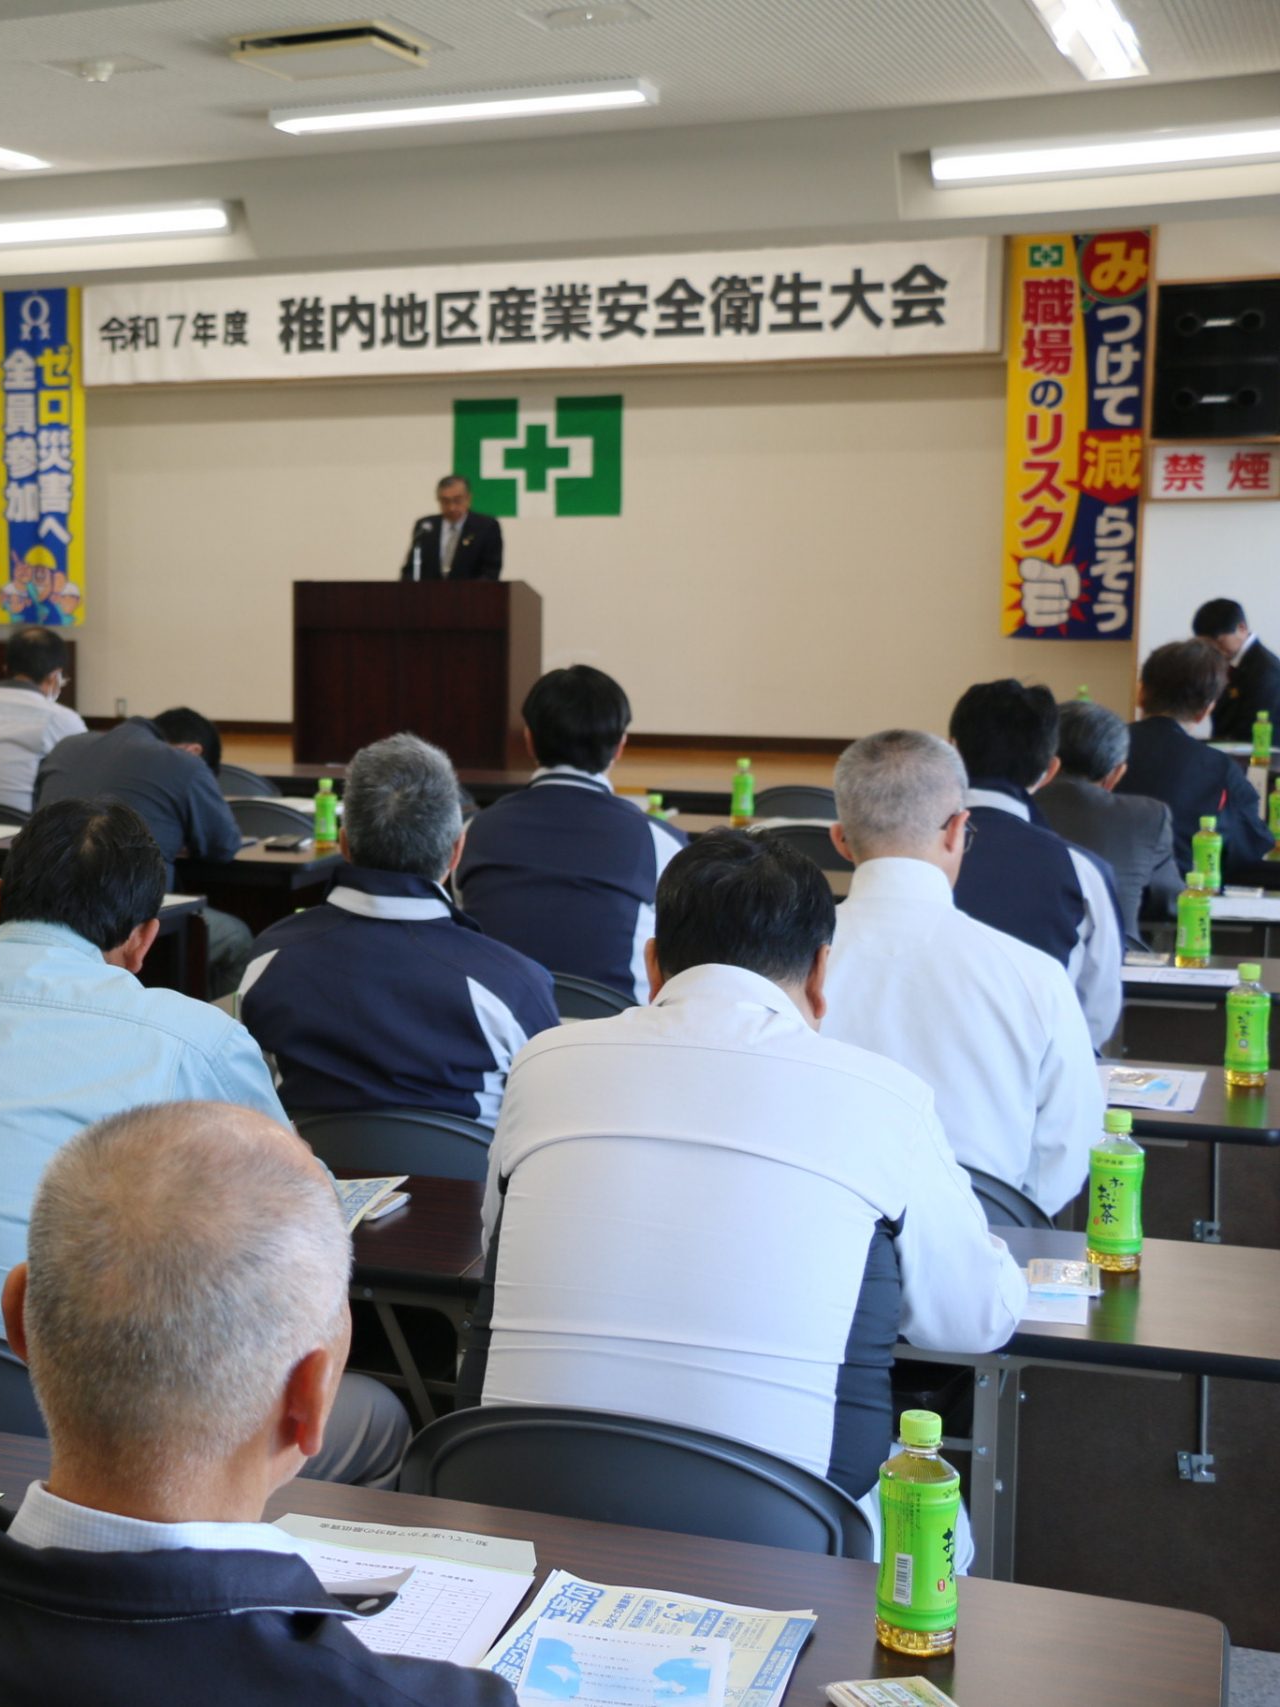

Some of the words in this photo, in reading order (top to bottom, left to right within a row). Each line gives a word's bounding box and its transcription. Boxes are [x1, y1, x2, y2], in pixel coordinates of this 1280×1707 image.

[99, 311, 250, 353] 令和7年度
[277, 263, 951, 356] 稚内地区産業安全衛生大会
[2, 348, 39, 523] 全員参加
[35, 345, 73, 545] ゼロ災害へ
[1019, 278, 1075, 550] 職場のリスク
[1082, 239, 1149, 634] みつけて減らそう
[1162, 452, 1272, 492] 禁煙
